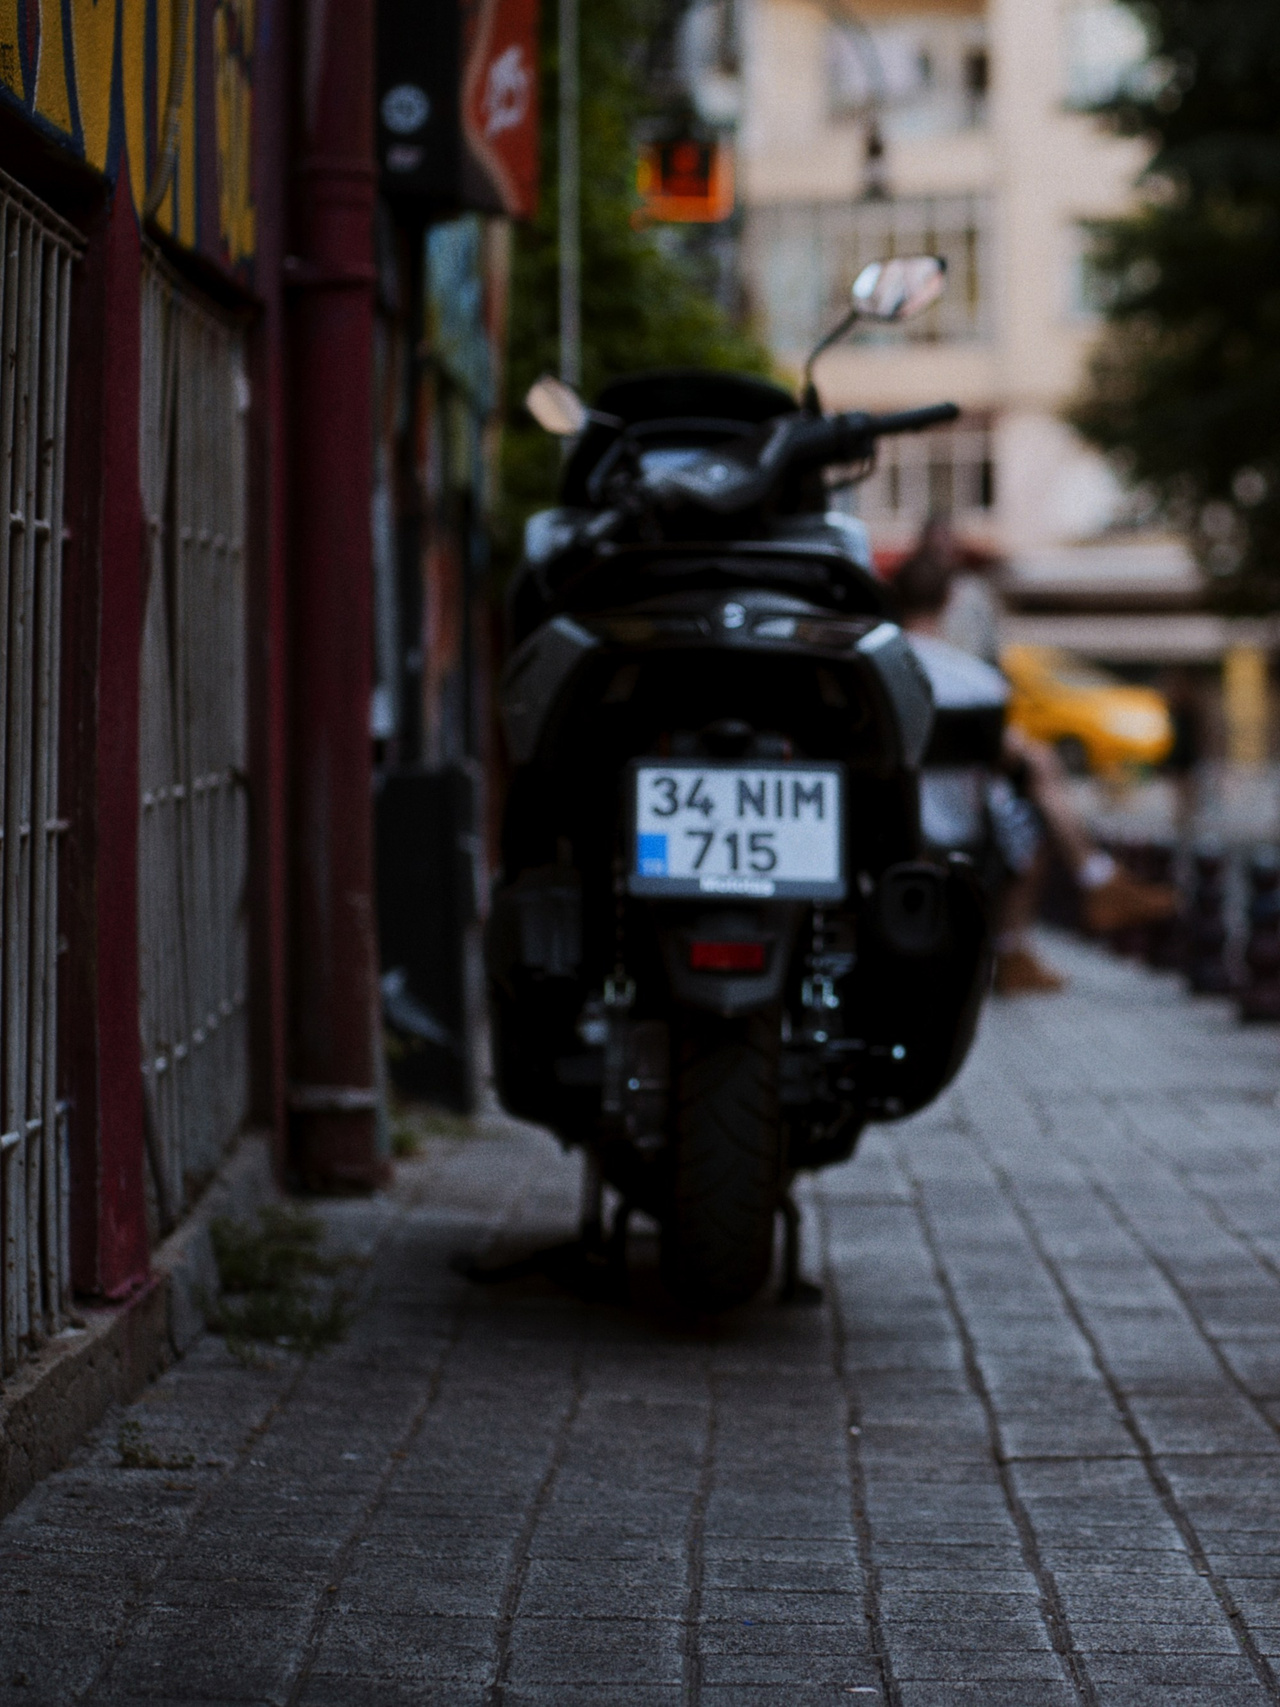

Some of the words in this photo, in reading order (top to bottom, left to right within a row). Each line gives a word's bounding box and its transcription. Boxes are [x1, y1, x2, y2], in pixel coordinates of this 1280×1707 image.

[653, 776, 714, 817] 34
[737, 778, 824, 820] NIM
[687, 830, 777, 872] 715
